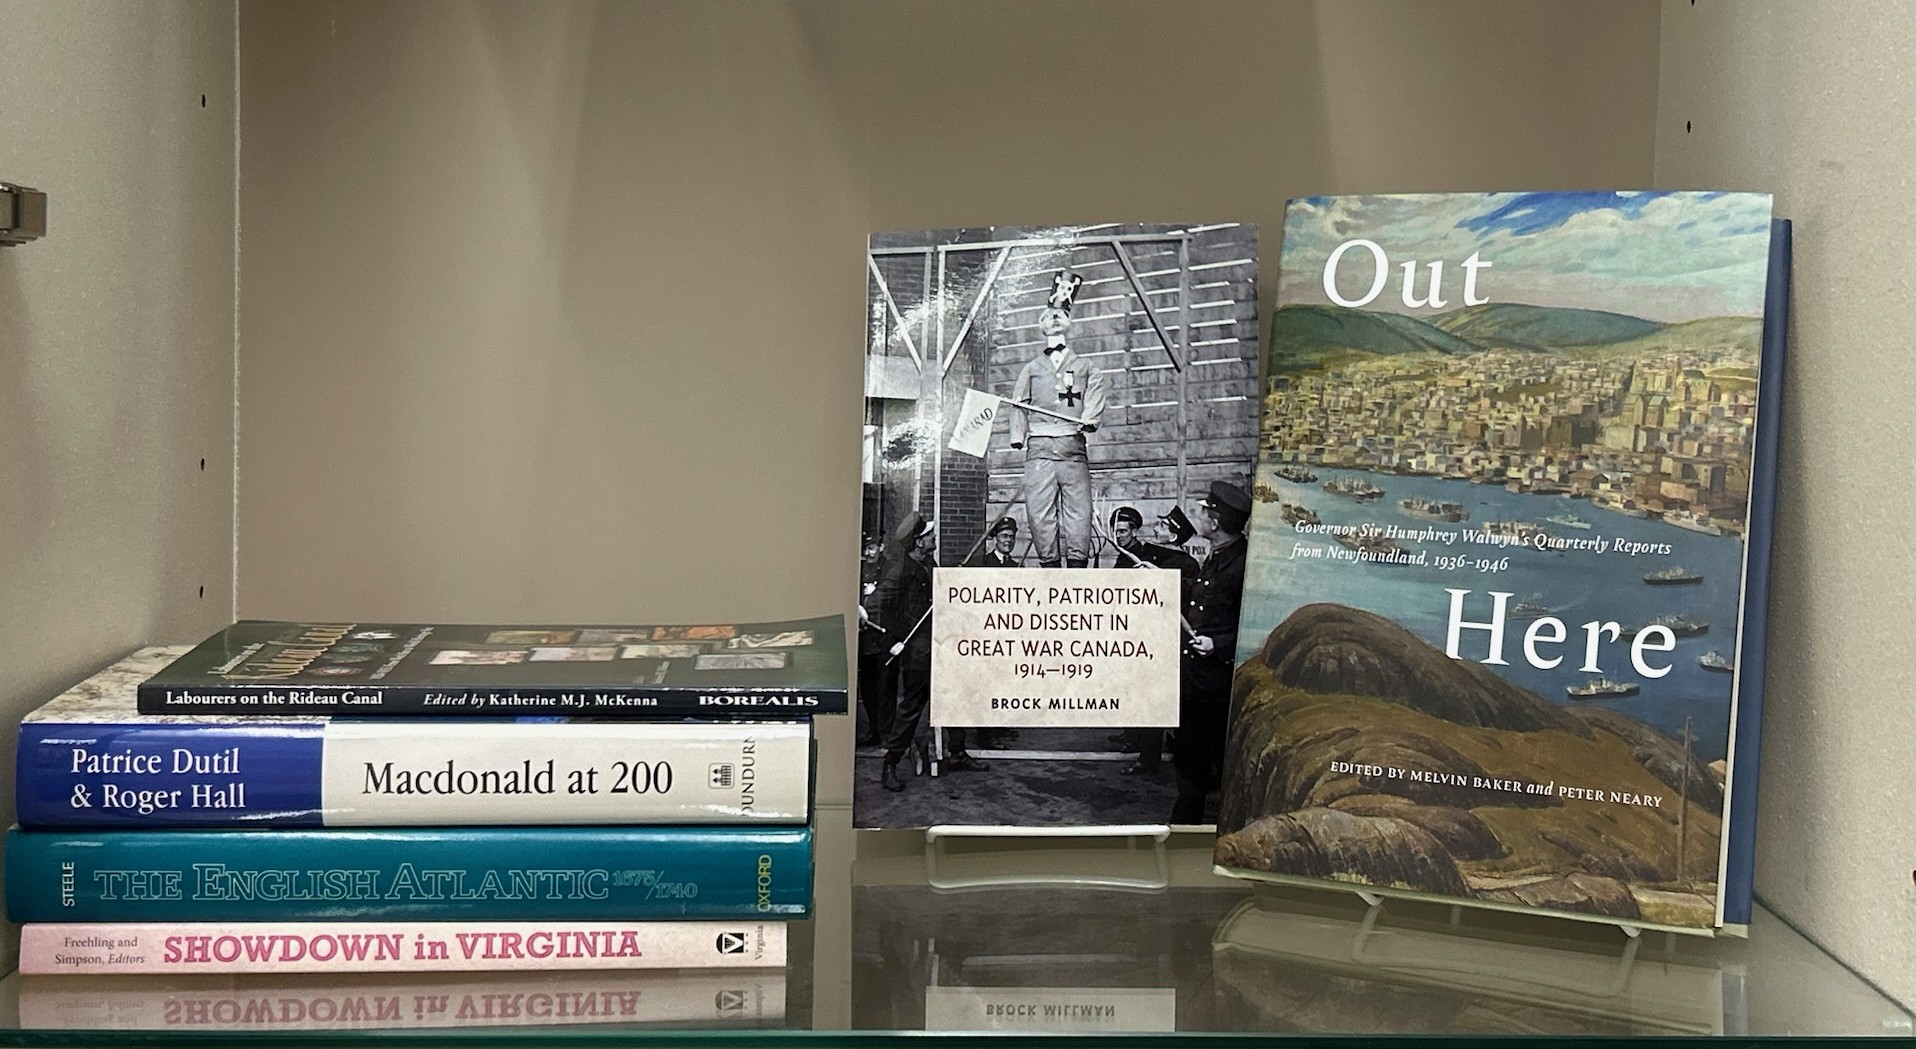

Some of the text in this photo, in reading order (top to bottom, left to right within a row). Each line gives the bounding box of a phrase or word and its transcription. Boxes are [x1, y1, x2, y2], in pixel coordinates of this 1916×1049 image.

[1324, 239, 1492, 308] Out
[1295, 520, 1671, 556] Governor Sir Humphrey Walwyn's Quarterly Reports
[1291, 543, 1321, 560] from
[1328, 545, 1428, 566] Newfoundland,
[950, 588, 1163, 607] POLARITY, PATRIOTISM,
[984, 614, 1127, 630] AND DISSENT IN
[1445, 588, 1675, 678] Here
[958, 640, 1153, 659] GREAT WAR CANADA,
[167, 691, 382, 704] Labourers on the Rideau Canal
[424, 694, 657, 708] Edited by Katherine M.J. McKenna
[700, 696, 818, 705] BOREALIS
[992, 699, 1119, 709] BROCK MILLMAN
[72, 748, 239, 773] Patrice Dutil
[363, 760, 672, 794] Macdonald at 200
[1331, 762, 1662, 807] EDITED BY MELVIN BAKER and PETER NEARY
[71, 783, 245, 814] & Roger Hall
[62, 862, 75, 906] STEELE
[94, 870, 182, 900] THE
[192, 863, 380, 900] ENGLISH
[386, 863, 609, 900] ATLANTIC
[758, 854, 772, 912] OXFORD
[64, 937, 137, 949] Freehling and
[164, 931, 642, 963] SHOWDOWN in VIRGINIA
[754, 925, 766, 960] Virginia
[56, 954, 145, 967] Simpson, Editors
